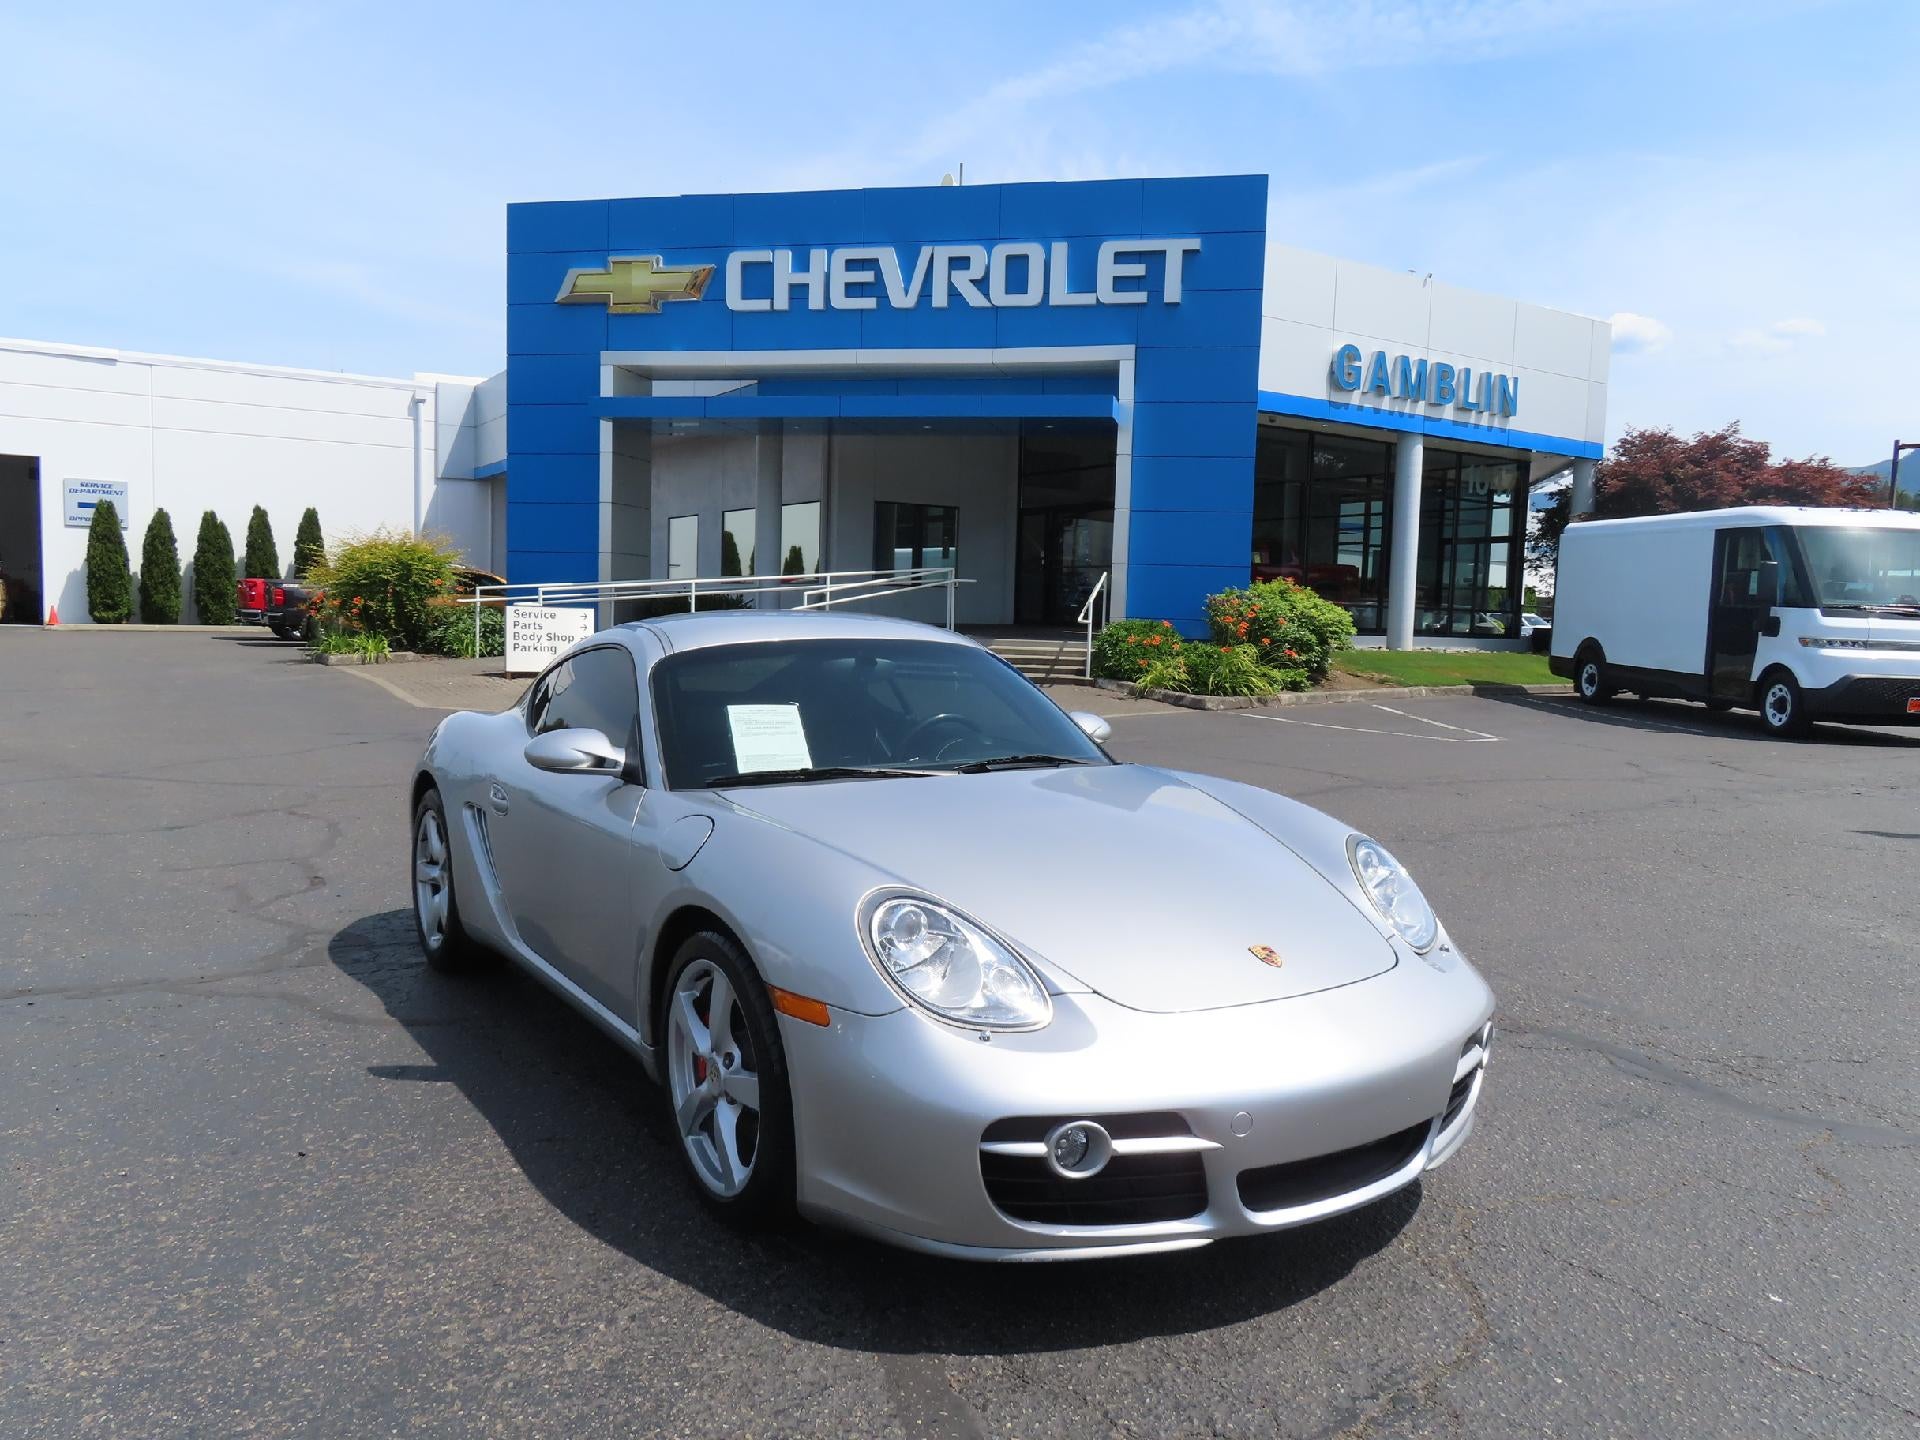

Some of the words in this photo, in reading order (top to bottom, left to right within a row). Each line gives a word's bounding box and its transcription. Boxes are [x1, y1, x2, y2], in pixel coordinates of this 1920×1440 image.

[726, 238, 1202, 312] CHEVROLET
[1333, 344, 1519, 417] GAMBLIN
[80, 481, 113, 489] SERVICE
[68, 488, 124, 496] DEPARTMENT
[513, 609, 557, 619] Service
[513, 621, 543, 630] Parts
[513, 632, 543, 643] Body
[546, 633, 575, 643] Shop
[513, 643, 557, 655] Parking
